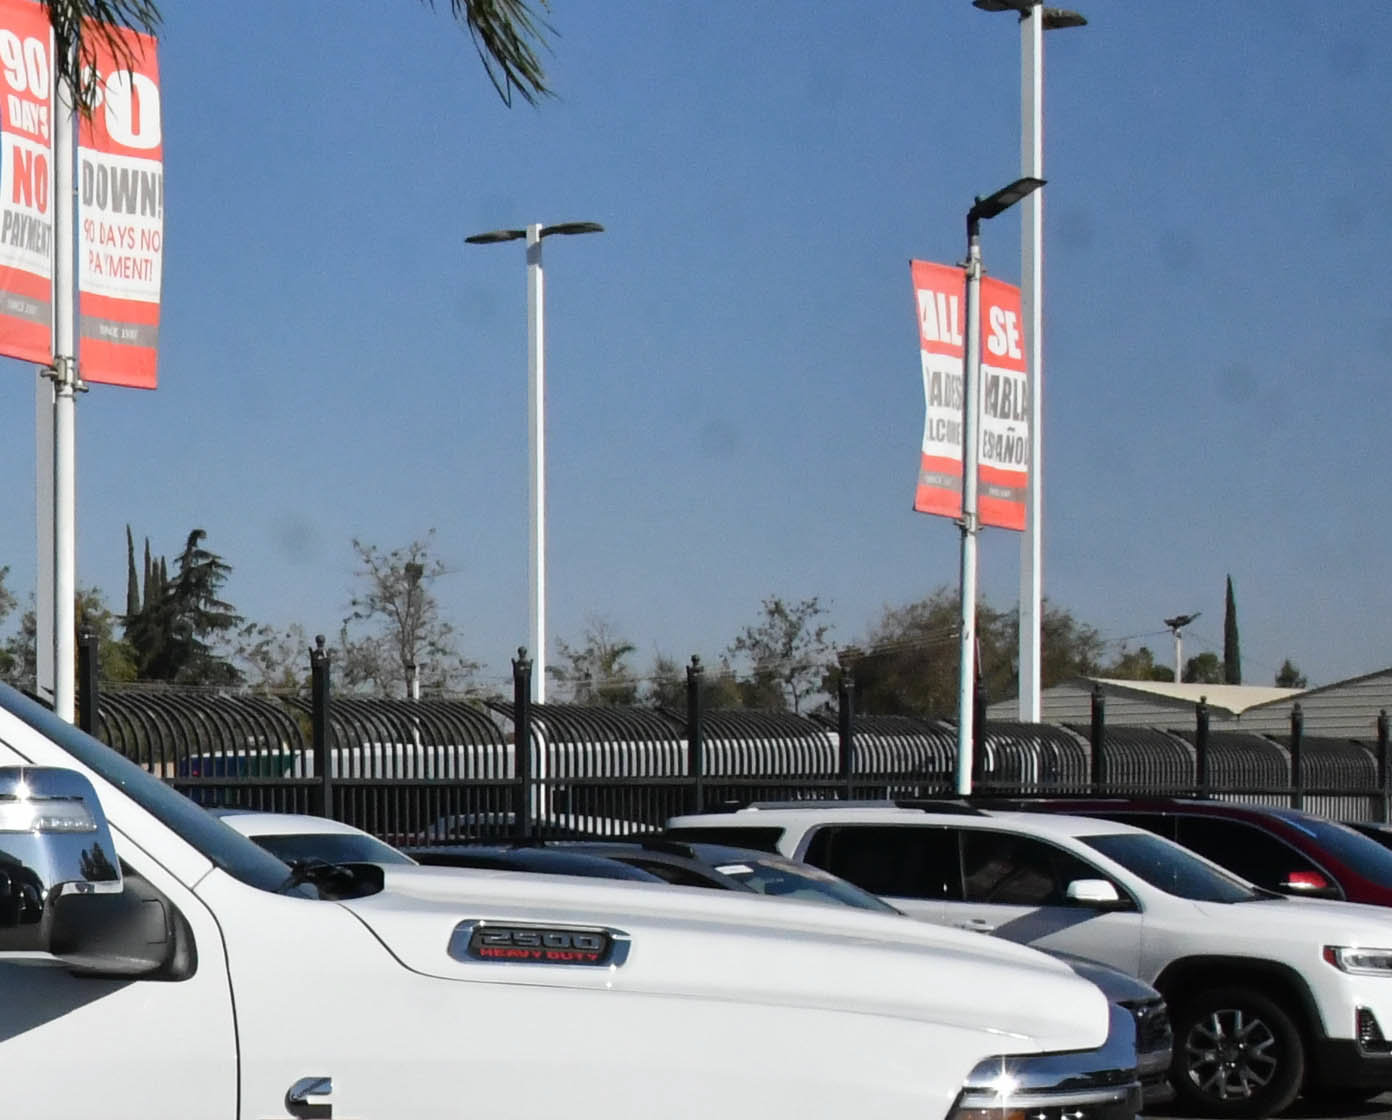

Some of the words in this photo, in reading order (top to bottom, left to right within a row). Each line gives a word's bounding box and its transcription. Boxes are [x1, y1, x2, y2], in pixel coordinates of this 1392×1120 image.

[7, 94, 49, 140] DAYS
[12, 144, 48, 215] NO
[82, 159, 162, 219] DOWN!
[99, 222, 135, 250] DAYS
[141, 229, 161, 253] NO
[918, 289, 962, 346] ALL
[988, 305, 1021, 360] SE
[479, 930, 602, 950] 2500
[480, 947, 542, 959] HEAVY
[546, 950, 599, 961] DUTY
